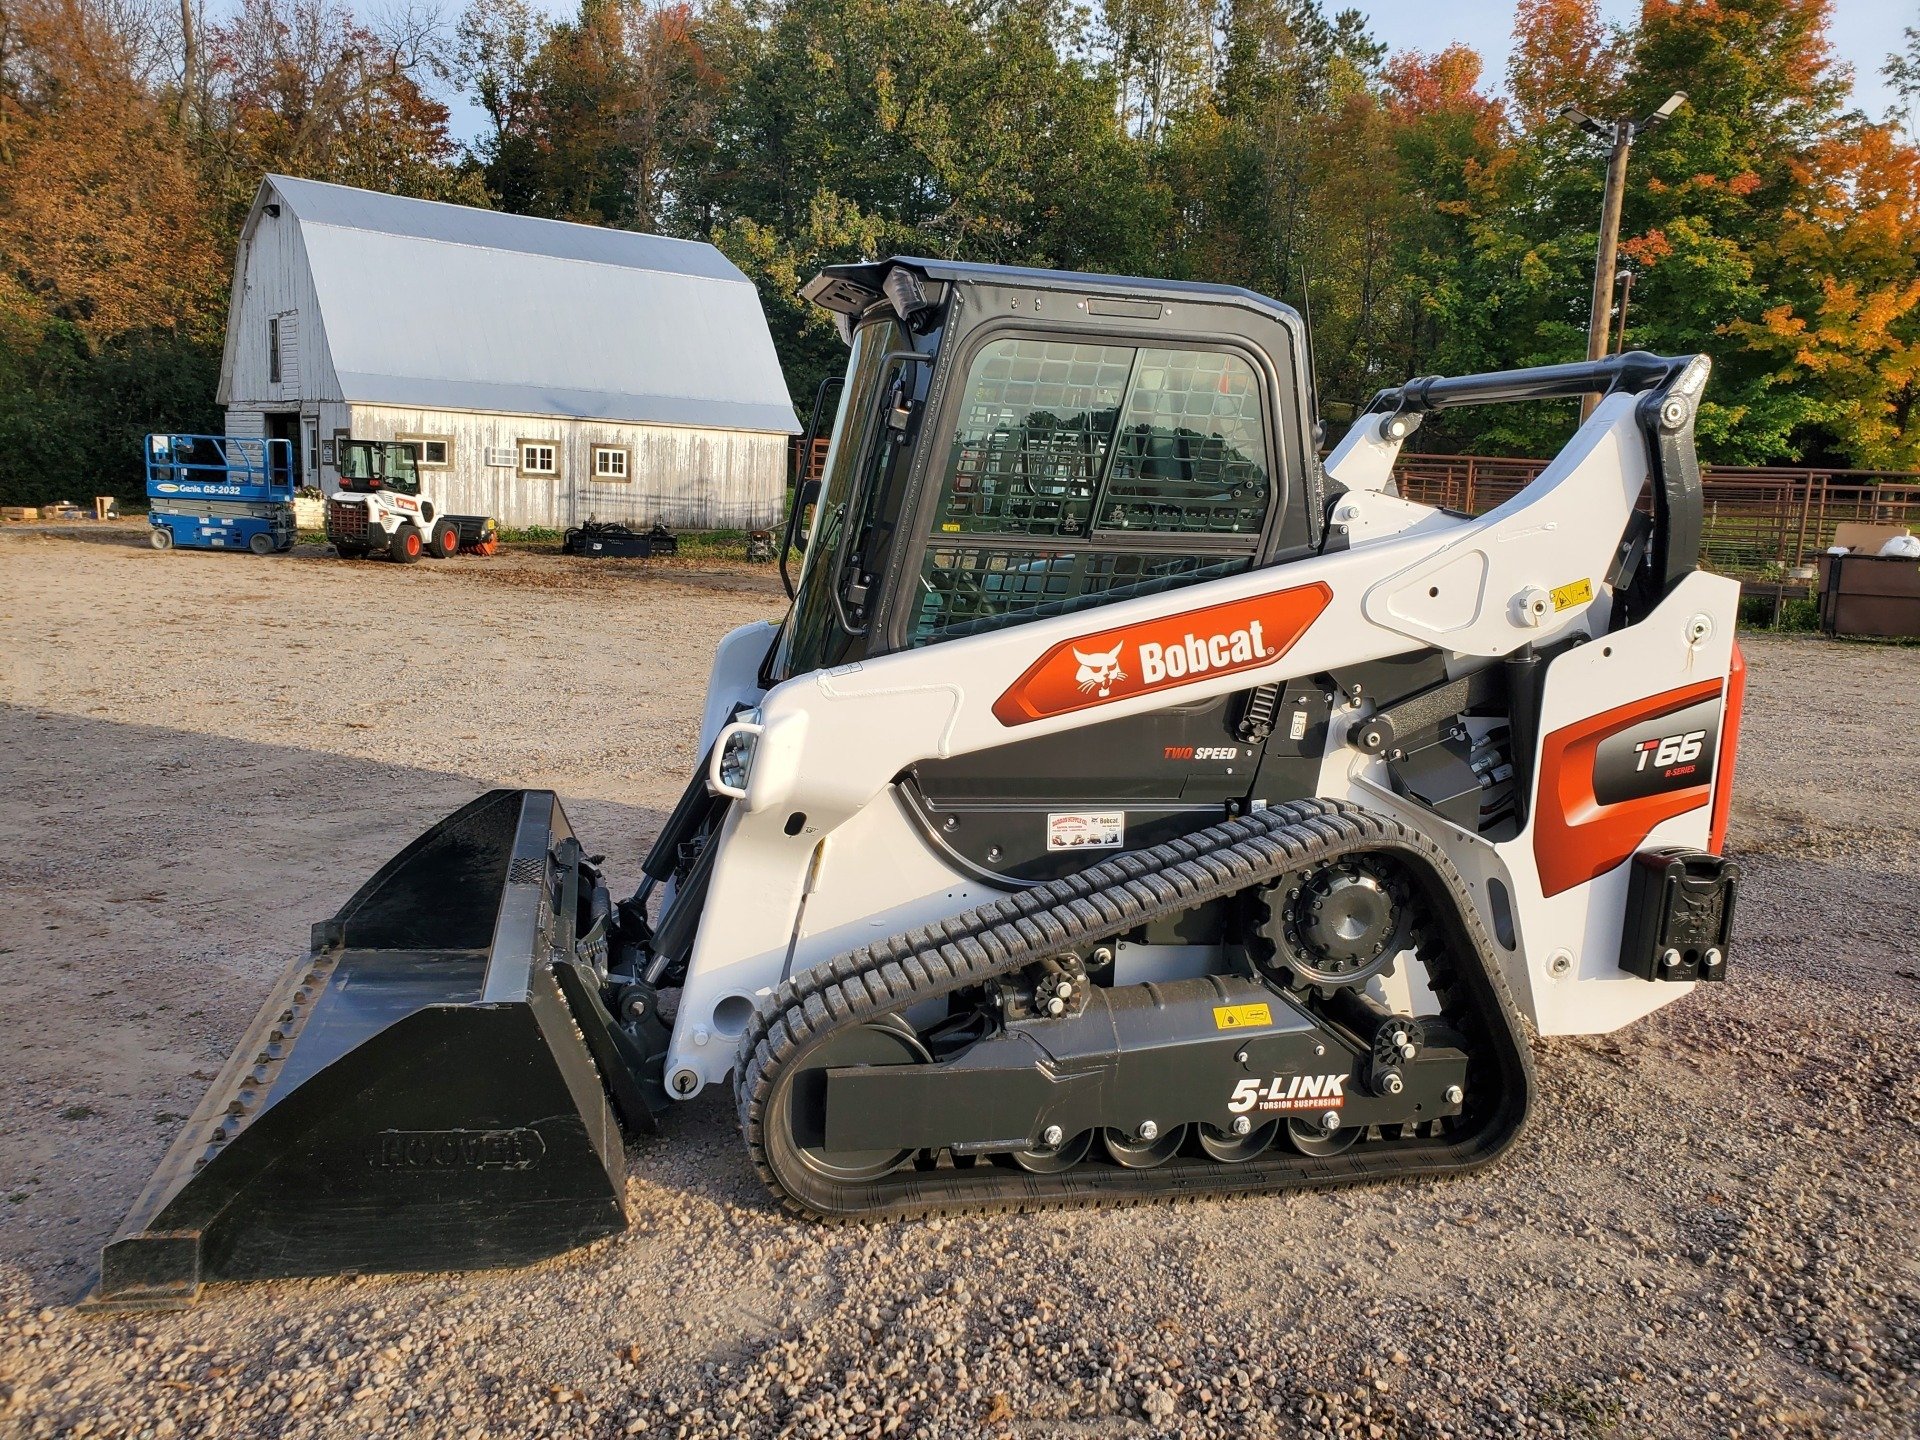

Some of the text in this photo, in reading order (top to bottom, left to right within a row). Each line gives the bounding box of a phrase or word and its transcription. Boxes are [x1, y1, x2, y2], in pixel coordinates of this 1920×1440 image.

[179, 484, 202, 493] Genie
[203, 485, 241, 495] GS-2032
[1139, 619, 1267, 685] Bobcat
[1164, 747, 1238, 760] TWO SPEED
[1634, 729, 1707, 772] T66
[1664, 764, 1697, 778] R-SERIES
[1227, 1073, 1350, 1113] 5-LINK
[1258, 1097, 1342, 1110] TORSION SUSPENSION
